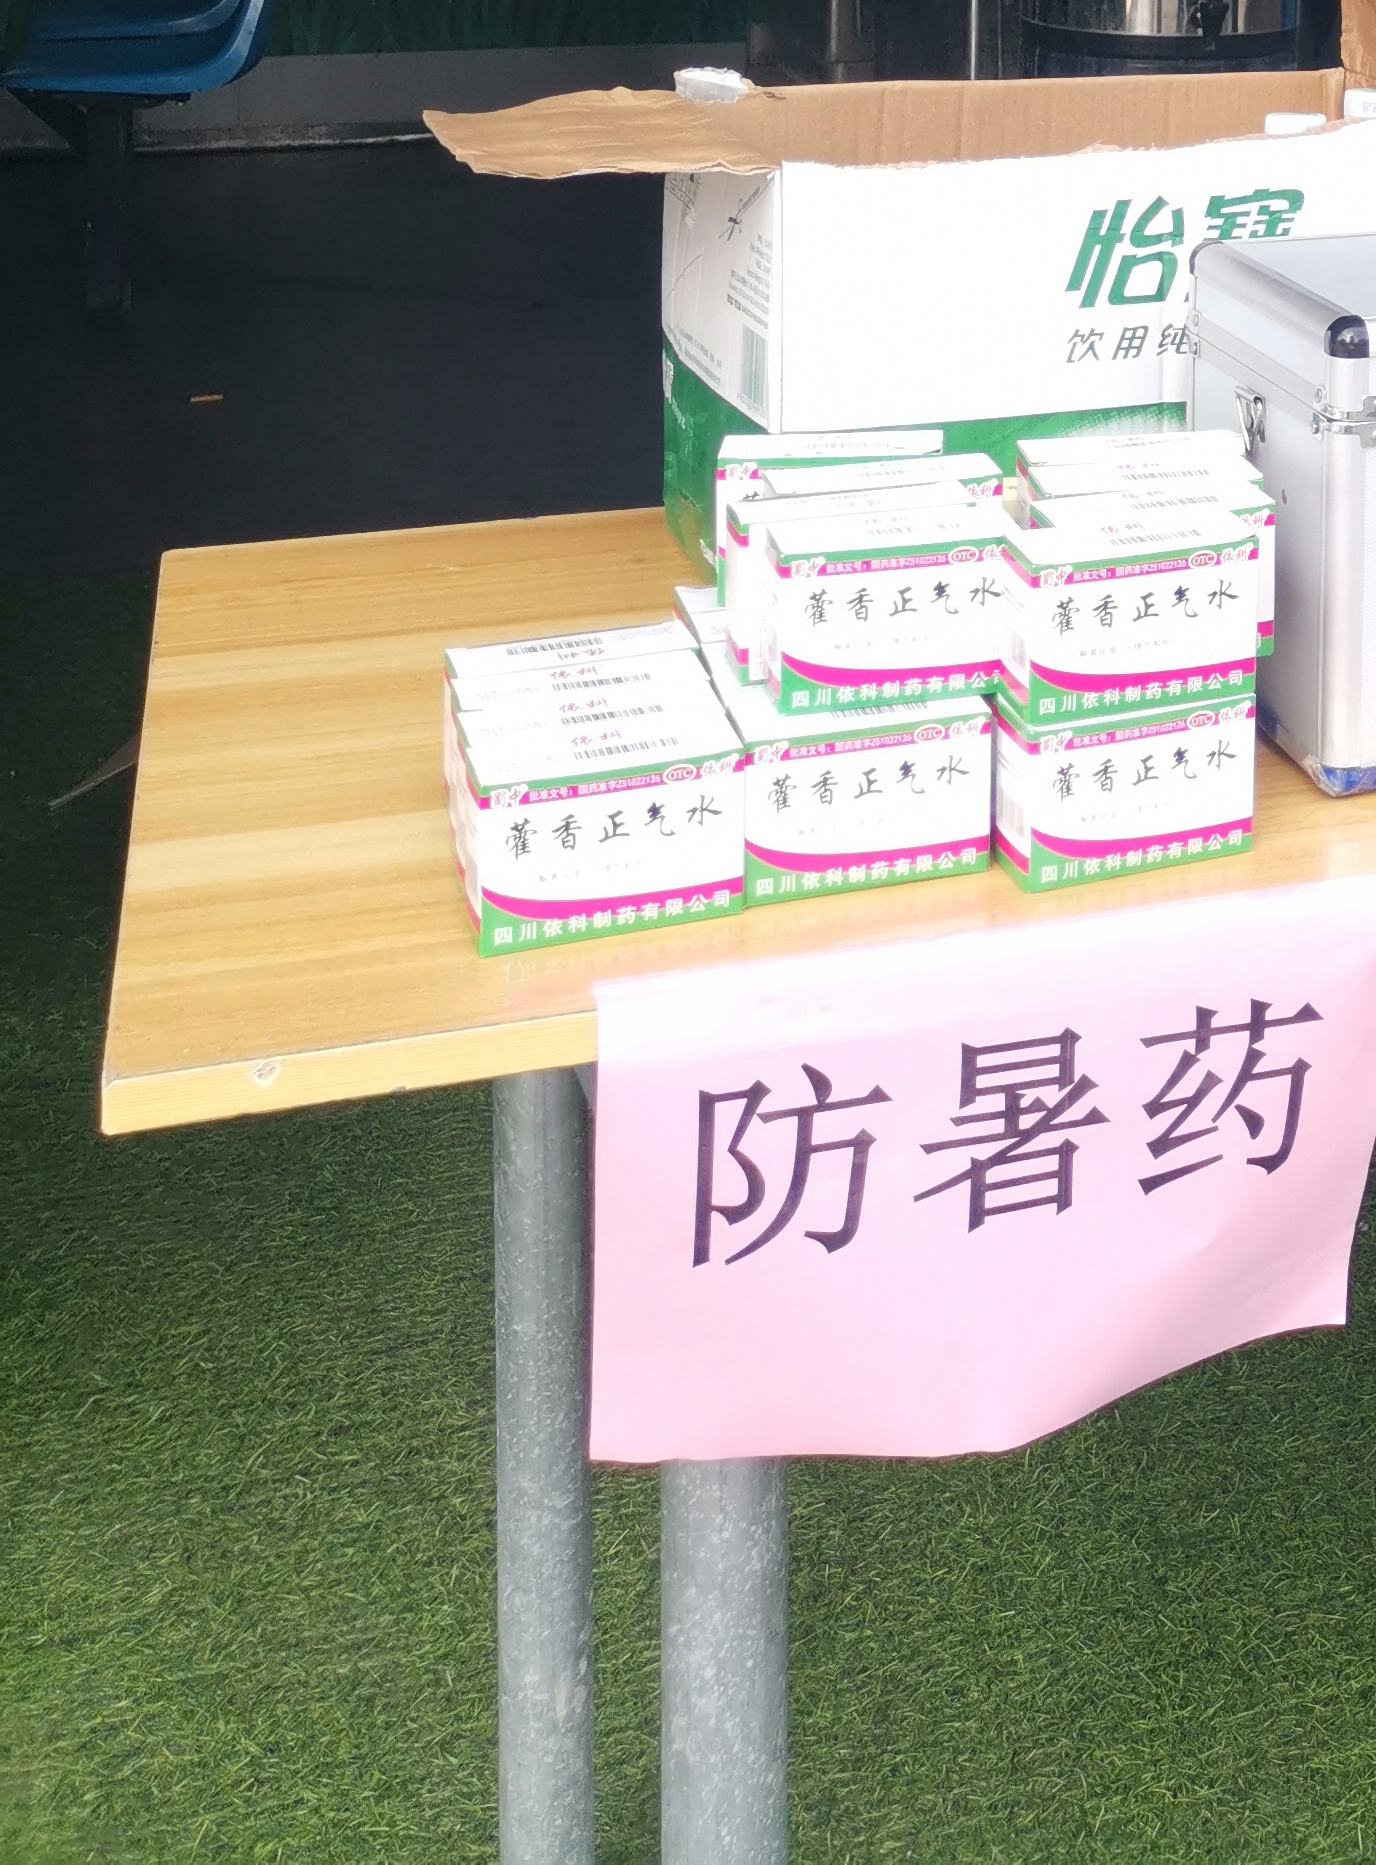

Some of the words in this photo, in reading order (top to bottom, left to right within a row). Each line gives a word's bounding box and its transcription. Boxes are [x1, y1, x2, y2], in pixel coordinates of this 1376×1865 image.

[951, 549, 976, 562] OTC
[1191, 554, 1215, 566] OTC
[804, 577, 1002, 628] 藿香正气水
[1052, 579, 1239, 637] 藿香正气水
[1039, 669, 1243, 715] 四川依科制药有限公司
[918, 728, 941, 742] OTC
[1190, 715, 1212, 727] OTC
[667, 766, 693, 781] OTC
[767, 754, 971, 815] 藿香正气水
[1052, 739, 1238, 803] 藿香正气水
[505, 794, 724, 861] 藿香正气水
[755, 847, 978, 897] 四川依科制药有限公司
[1041, 829, 1243, 884] 四川依科制药有限公司
[493, 889, 731, 946] 四川依科制药有限公司
[691, 997, 1324, 1269] 防暑药
